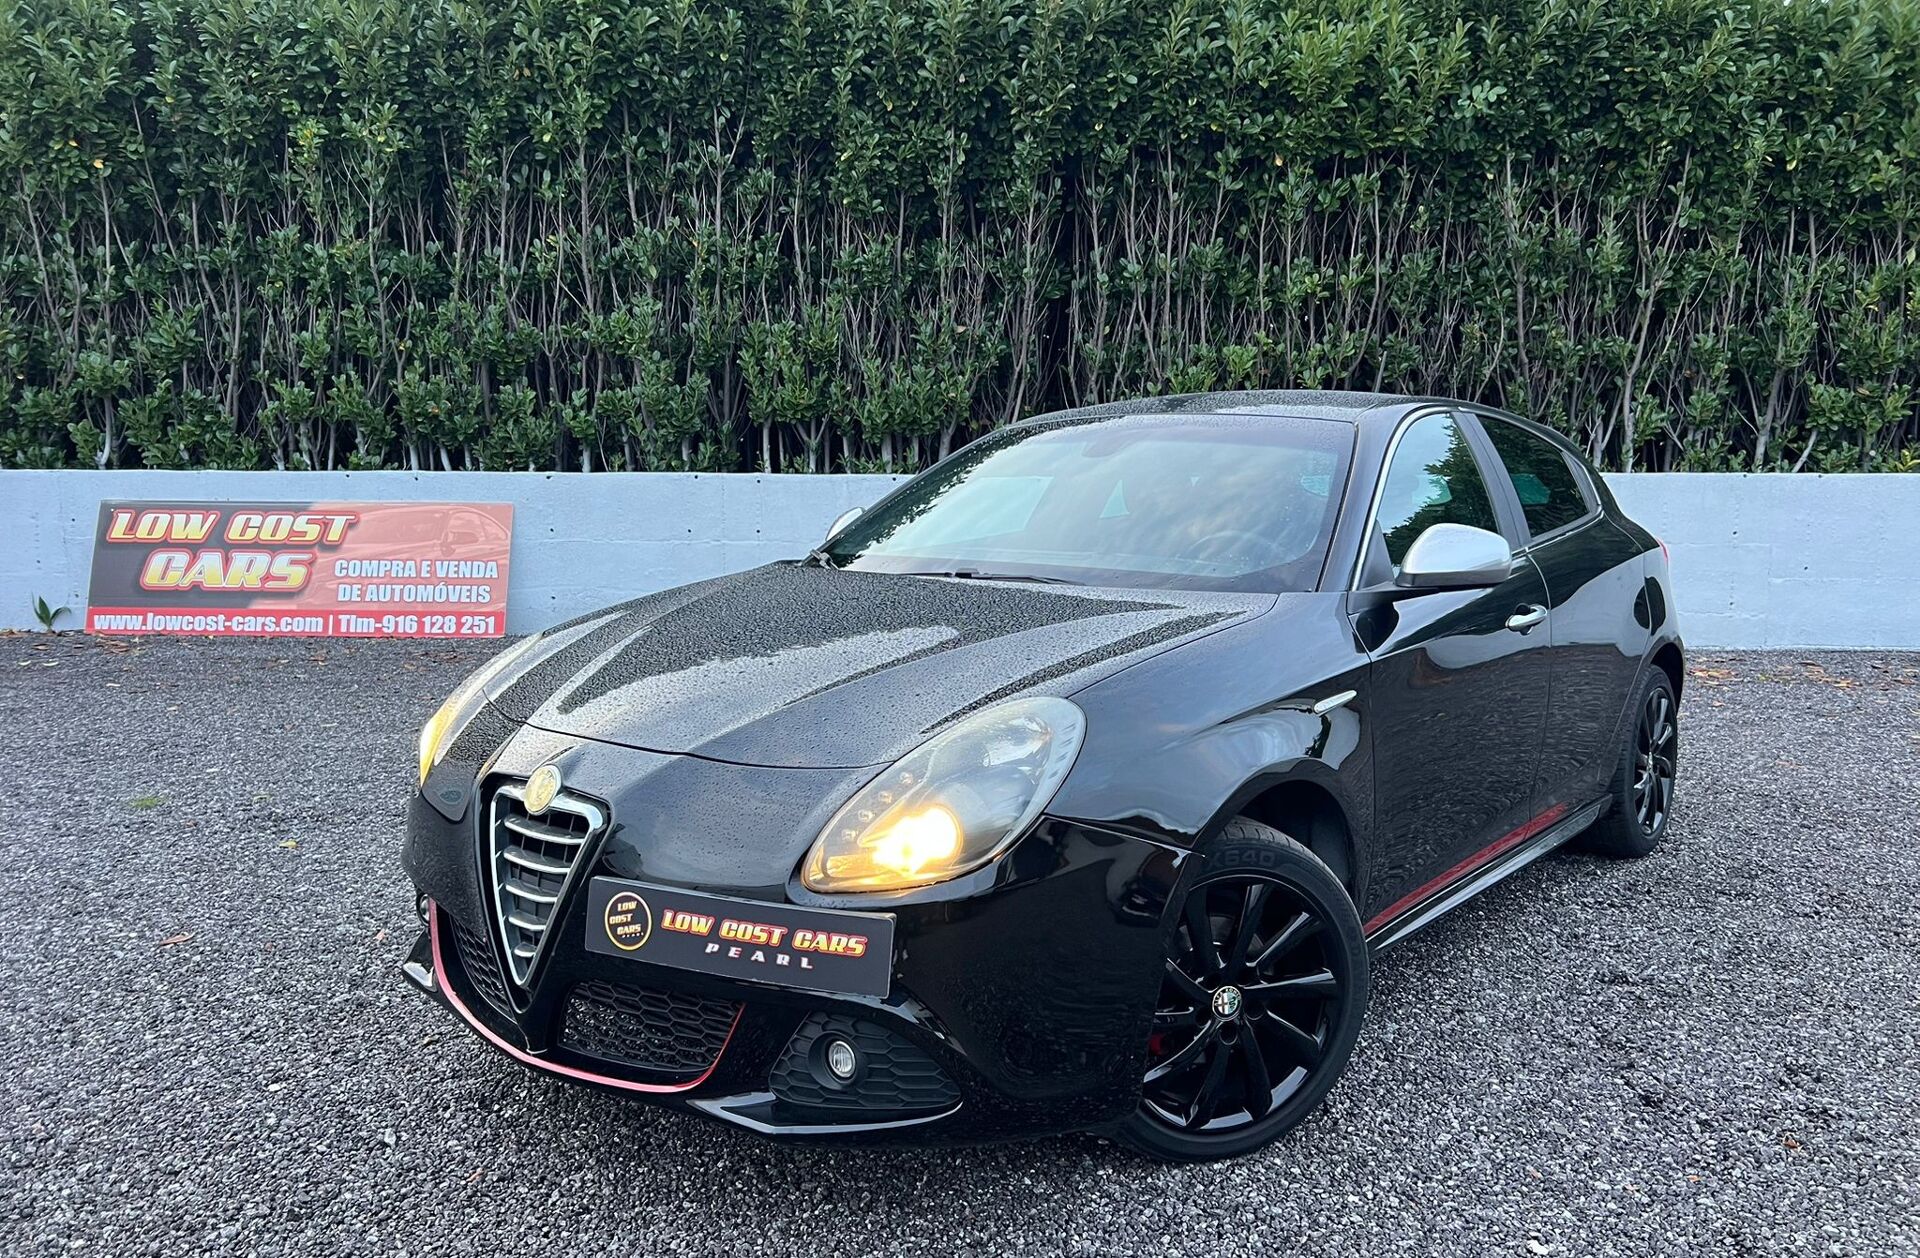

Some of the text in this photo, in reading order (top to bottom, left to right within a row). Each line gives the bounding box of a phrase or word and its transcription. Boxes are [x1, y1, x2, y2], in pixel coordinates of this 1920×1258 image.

[108, 511, 357, 542] LOW COST
[143, 550, 314, 588] CARS
[335, 559, 499, 579] COMPRA E VENDA
[337, 582, 491, 603] DE AUTOMÓVEIS
[93, 612, 324, 633] www.lowcost-cars.com
[338, 614, 418, 634] Tlm-916
[422, 615, 457, 634] 128
[460, 615, 495, 635] 251
[617, 900, 638, 912] LOW
[609, 913, 634, 925] COST
[616, 923, 642, 936] CARS
[661, 910, 868, 956] LOW COST CARS
[704, 942, 814, 969] PEARL
